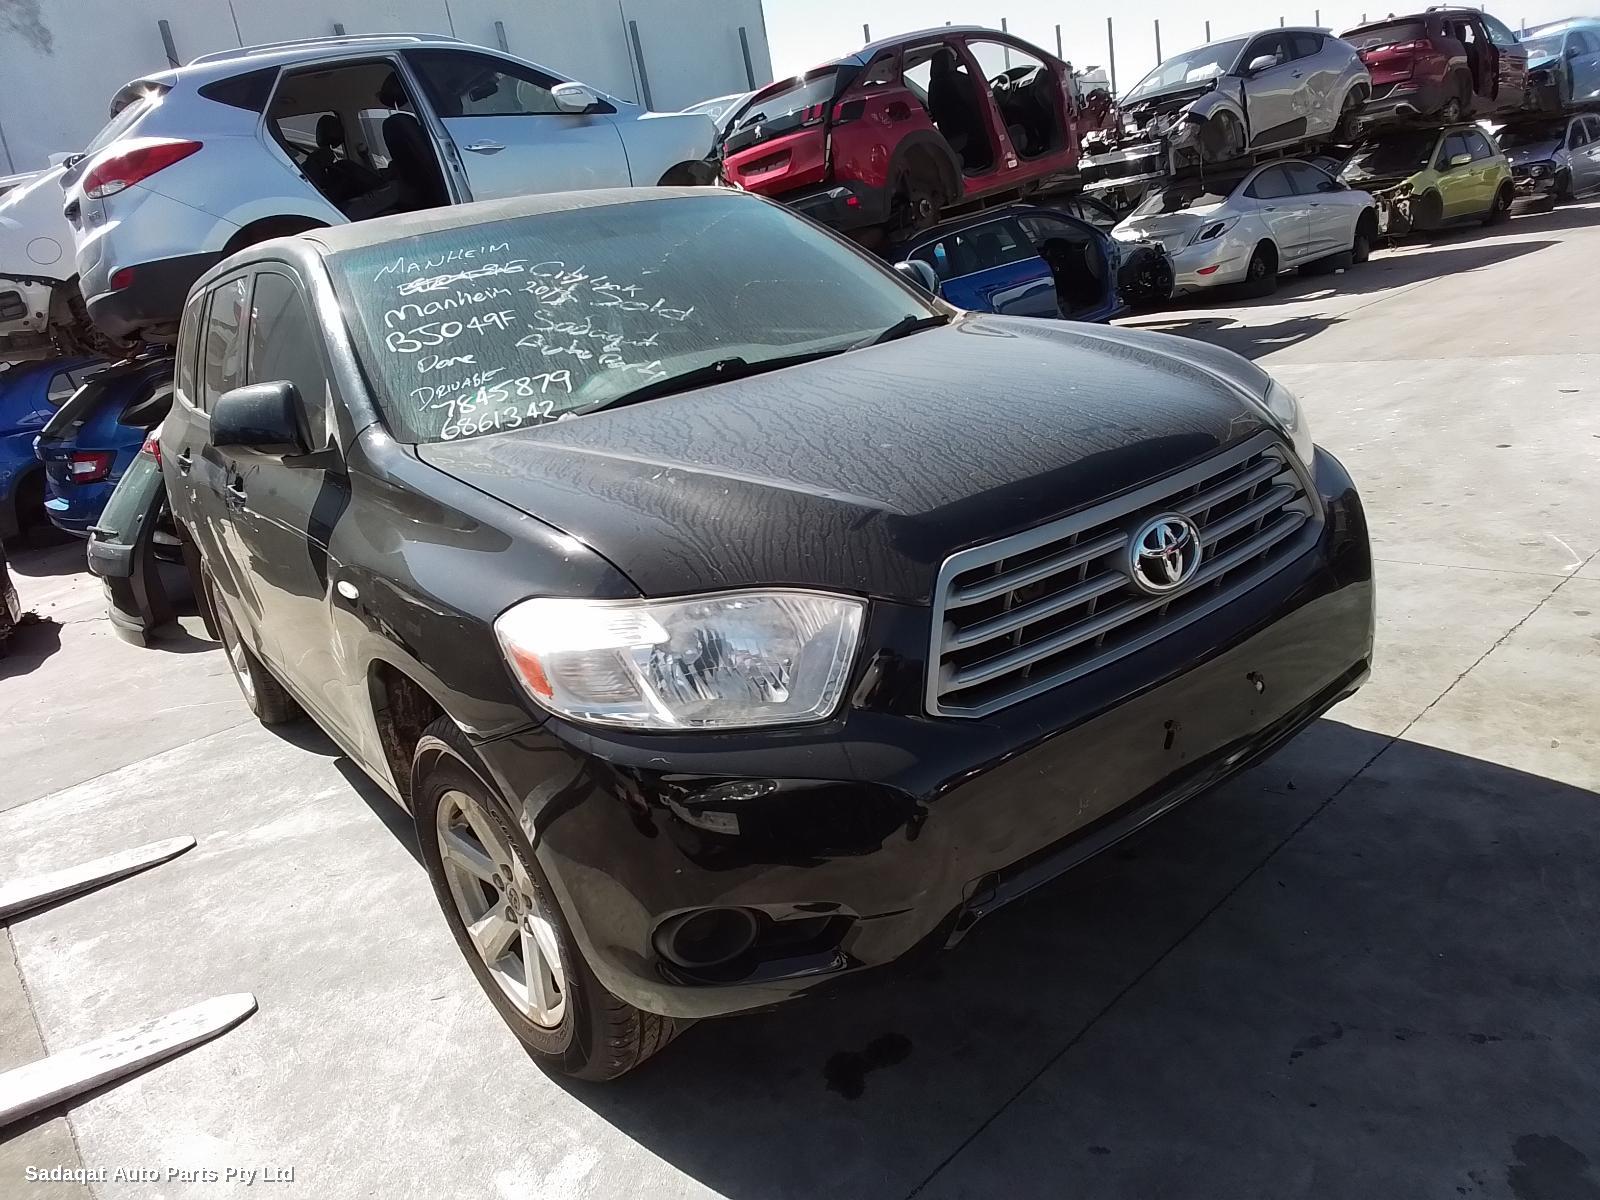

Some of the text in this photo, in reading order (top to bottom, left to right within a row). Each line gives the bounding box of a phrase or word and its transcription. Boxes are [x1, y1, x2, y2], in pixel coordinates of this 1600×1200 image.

[374, 242, 510, 282] MANHEIM
[384, 287, 512, 328] Manheim
[431, 369, 573, 418] 7845879
[440, 400, 558, 440] 6861342
